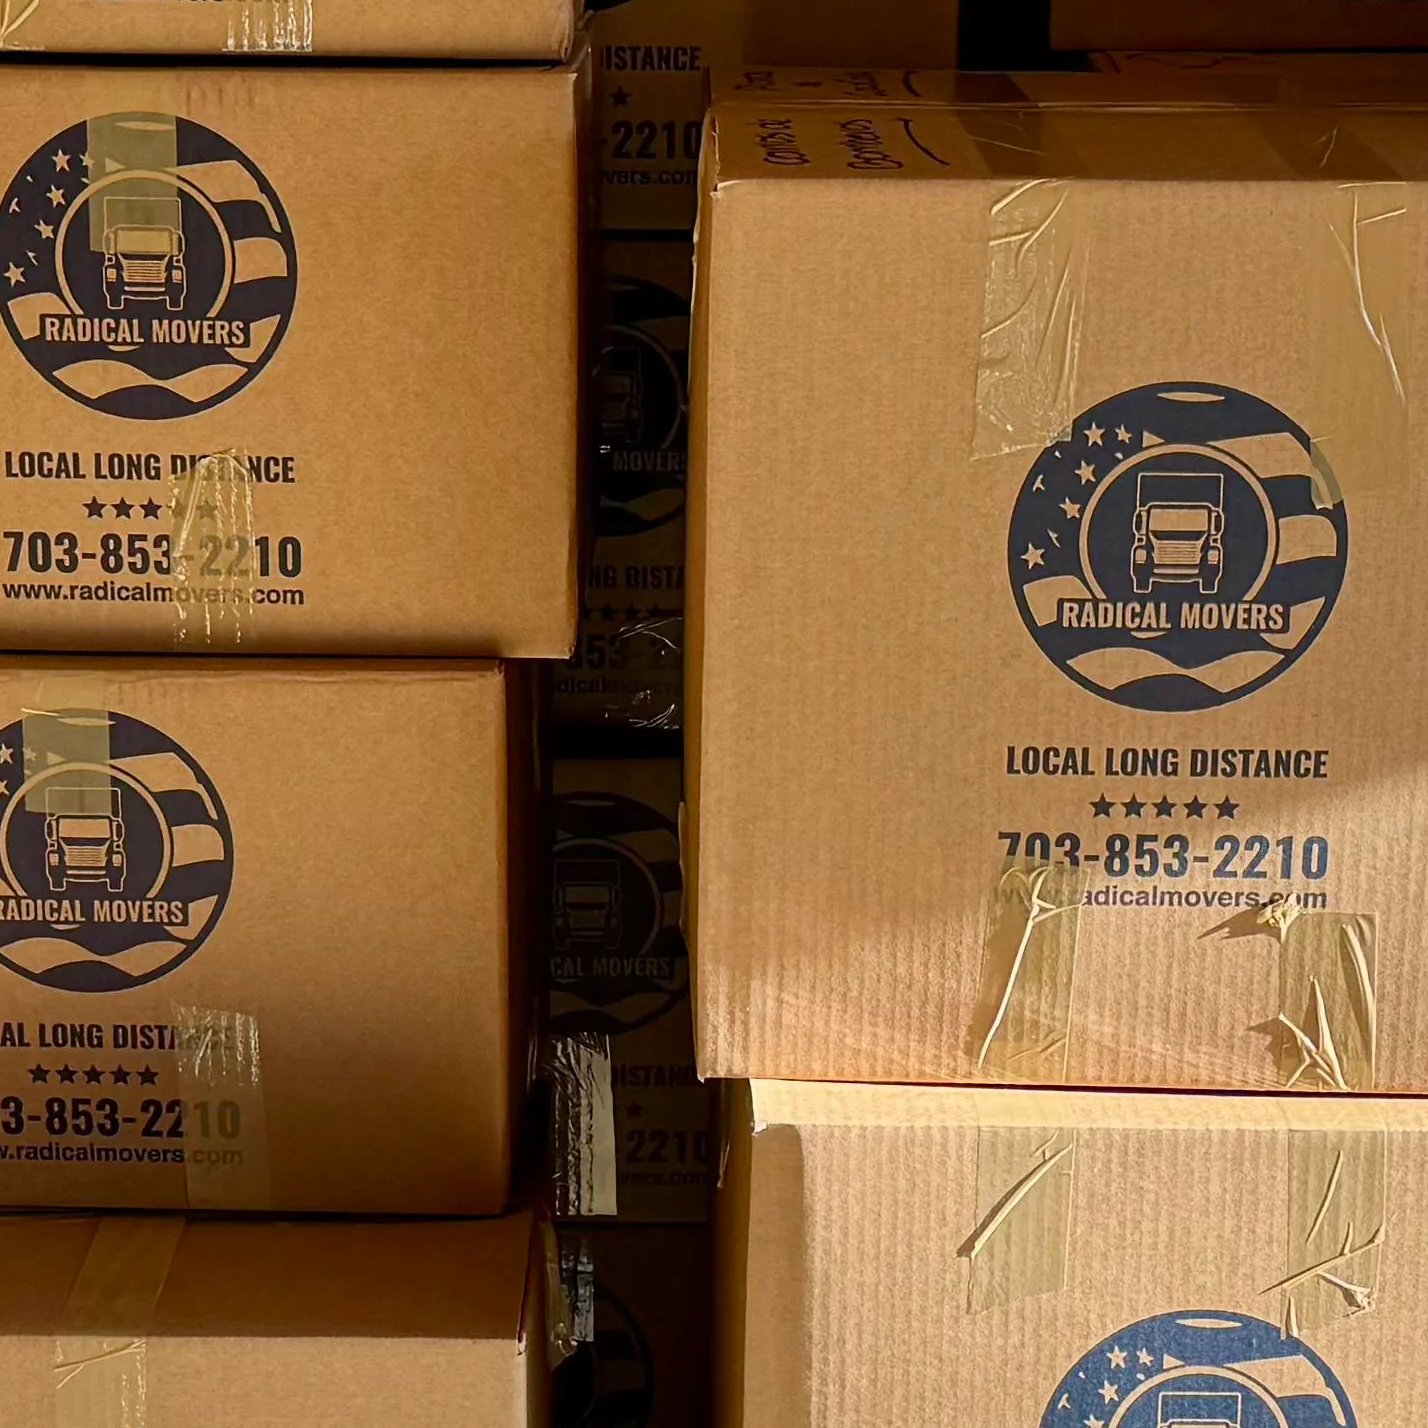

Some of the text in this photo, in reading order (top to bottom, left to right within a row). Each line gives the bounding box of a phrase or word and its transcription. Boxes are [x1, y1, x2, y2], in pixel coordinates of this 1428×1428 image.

[601, 46, 702, 71] ISTANCE
[44, 317, 245, 345] RADICAL MOVERS
[5, 451, 161, 481] LOCAL LONG
[1062, 602, 1284, 631] RADICAL MOVERS
[1006, 745, 1329, 779] LOCAL LONG DISTANCE
[93, 900, 183, 924] MOVERS
[38, 1022, 103, 1049] LONG
